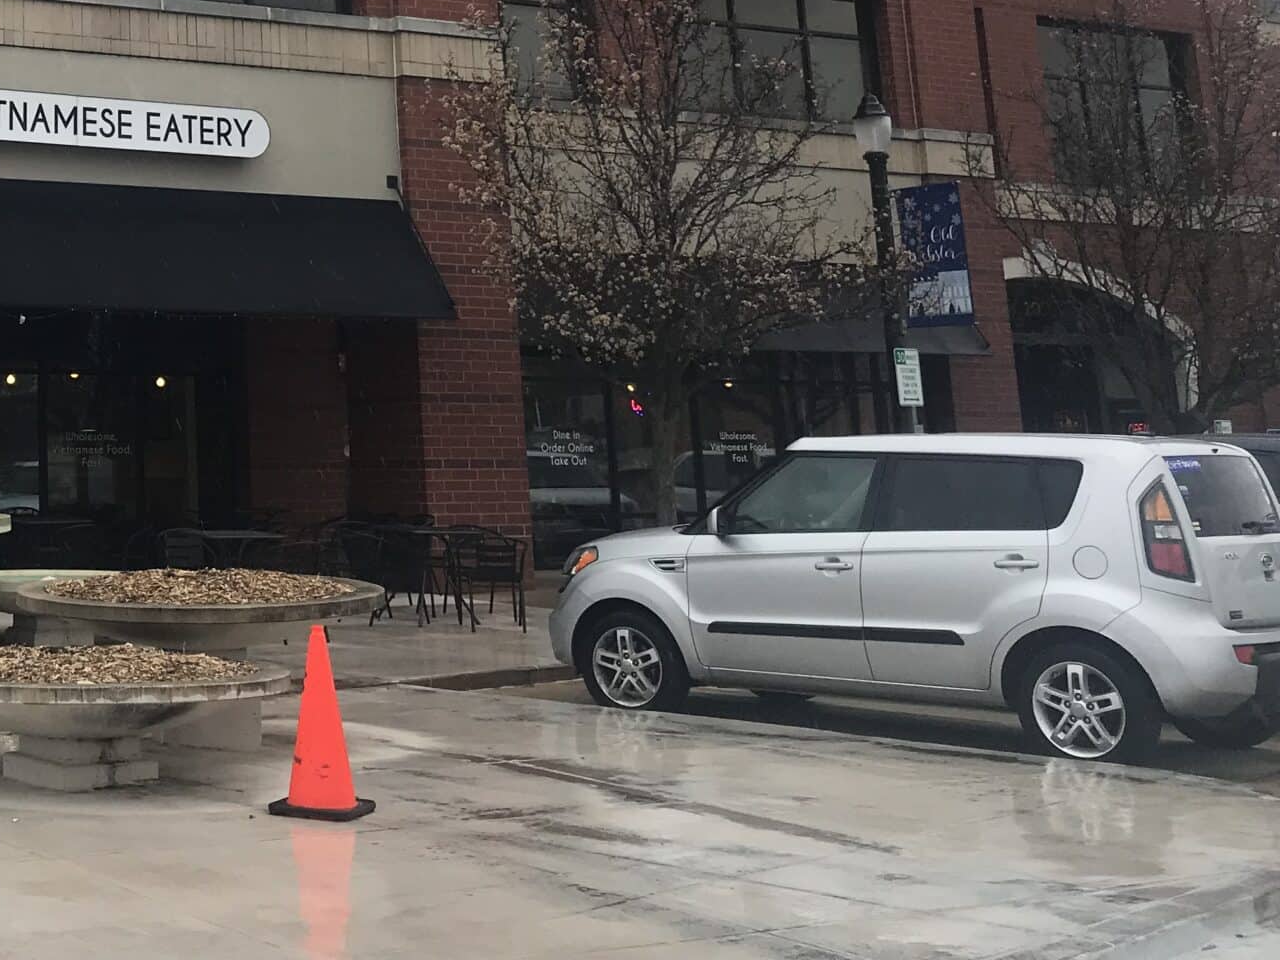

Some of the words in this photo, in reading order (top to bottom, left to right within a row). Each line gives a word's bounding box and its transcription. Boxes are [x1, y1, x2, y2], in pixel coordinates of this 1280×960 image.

[146, 112, 253, 148] EATERY
[553, 430, 570, 439] Dine
[541, 442, 565, 452] Order
[568, 442, 594, 452] Online
[550, 456, 568, 465] Take
[571, 455, 587, 465] Out
